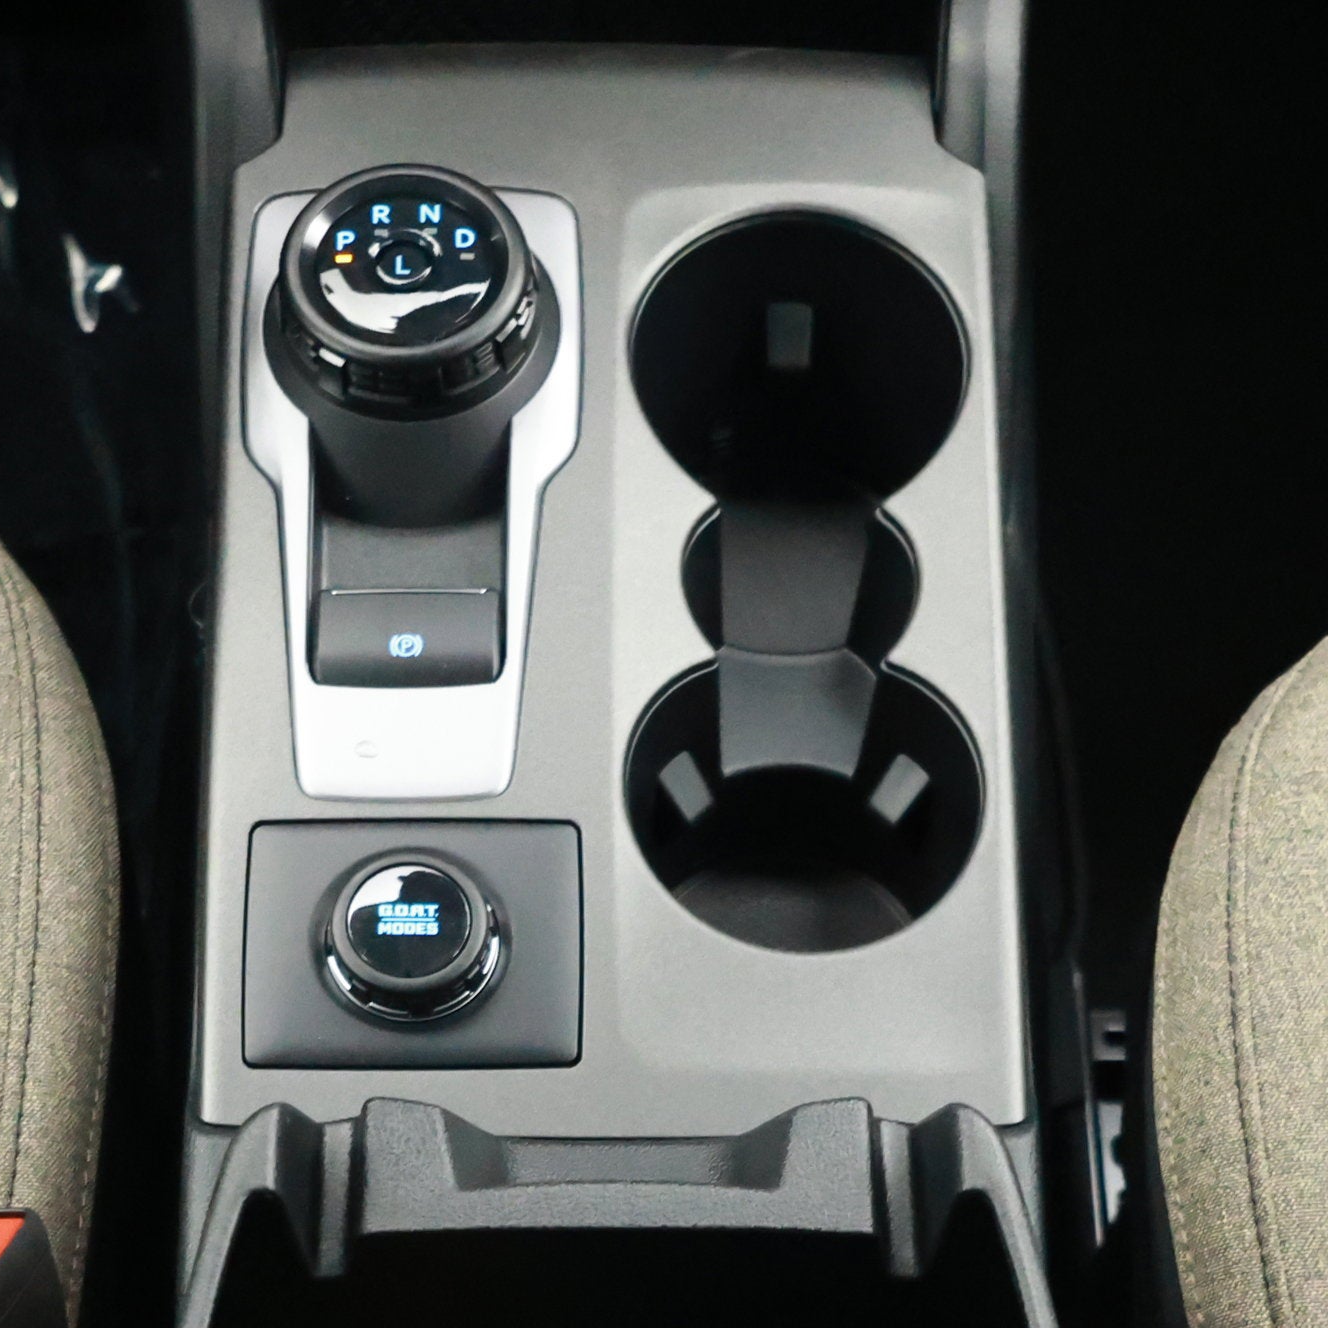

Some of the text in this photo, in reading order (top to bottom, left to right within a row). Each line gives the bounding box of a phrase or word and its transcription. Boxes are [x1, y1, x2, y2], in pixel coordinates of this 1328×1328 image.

[335, 204, 476, 250] P R N D
[394, 255, 412, 275] L
[377, 922, 440, 936] MODES
